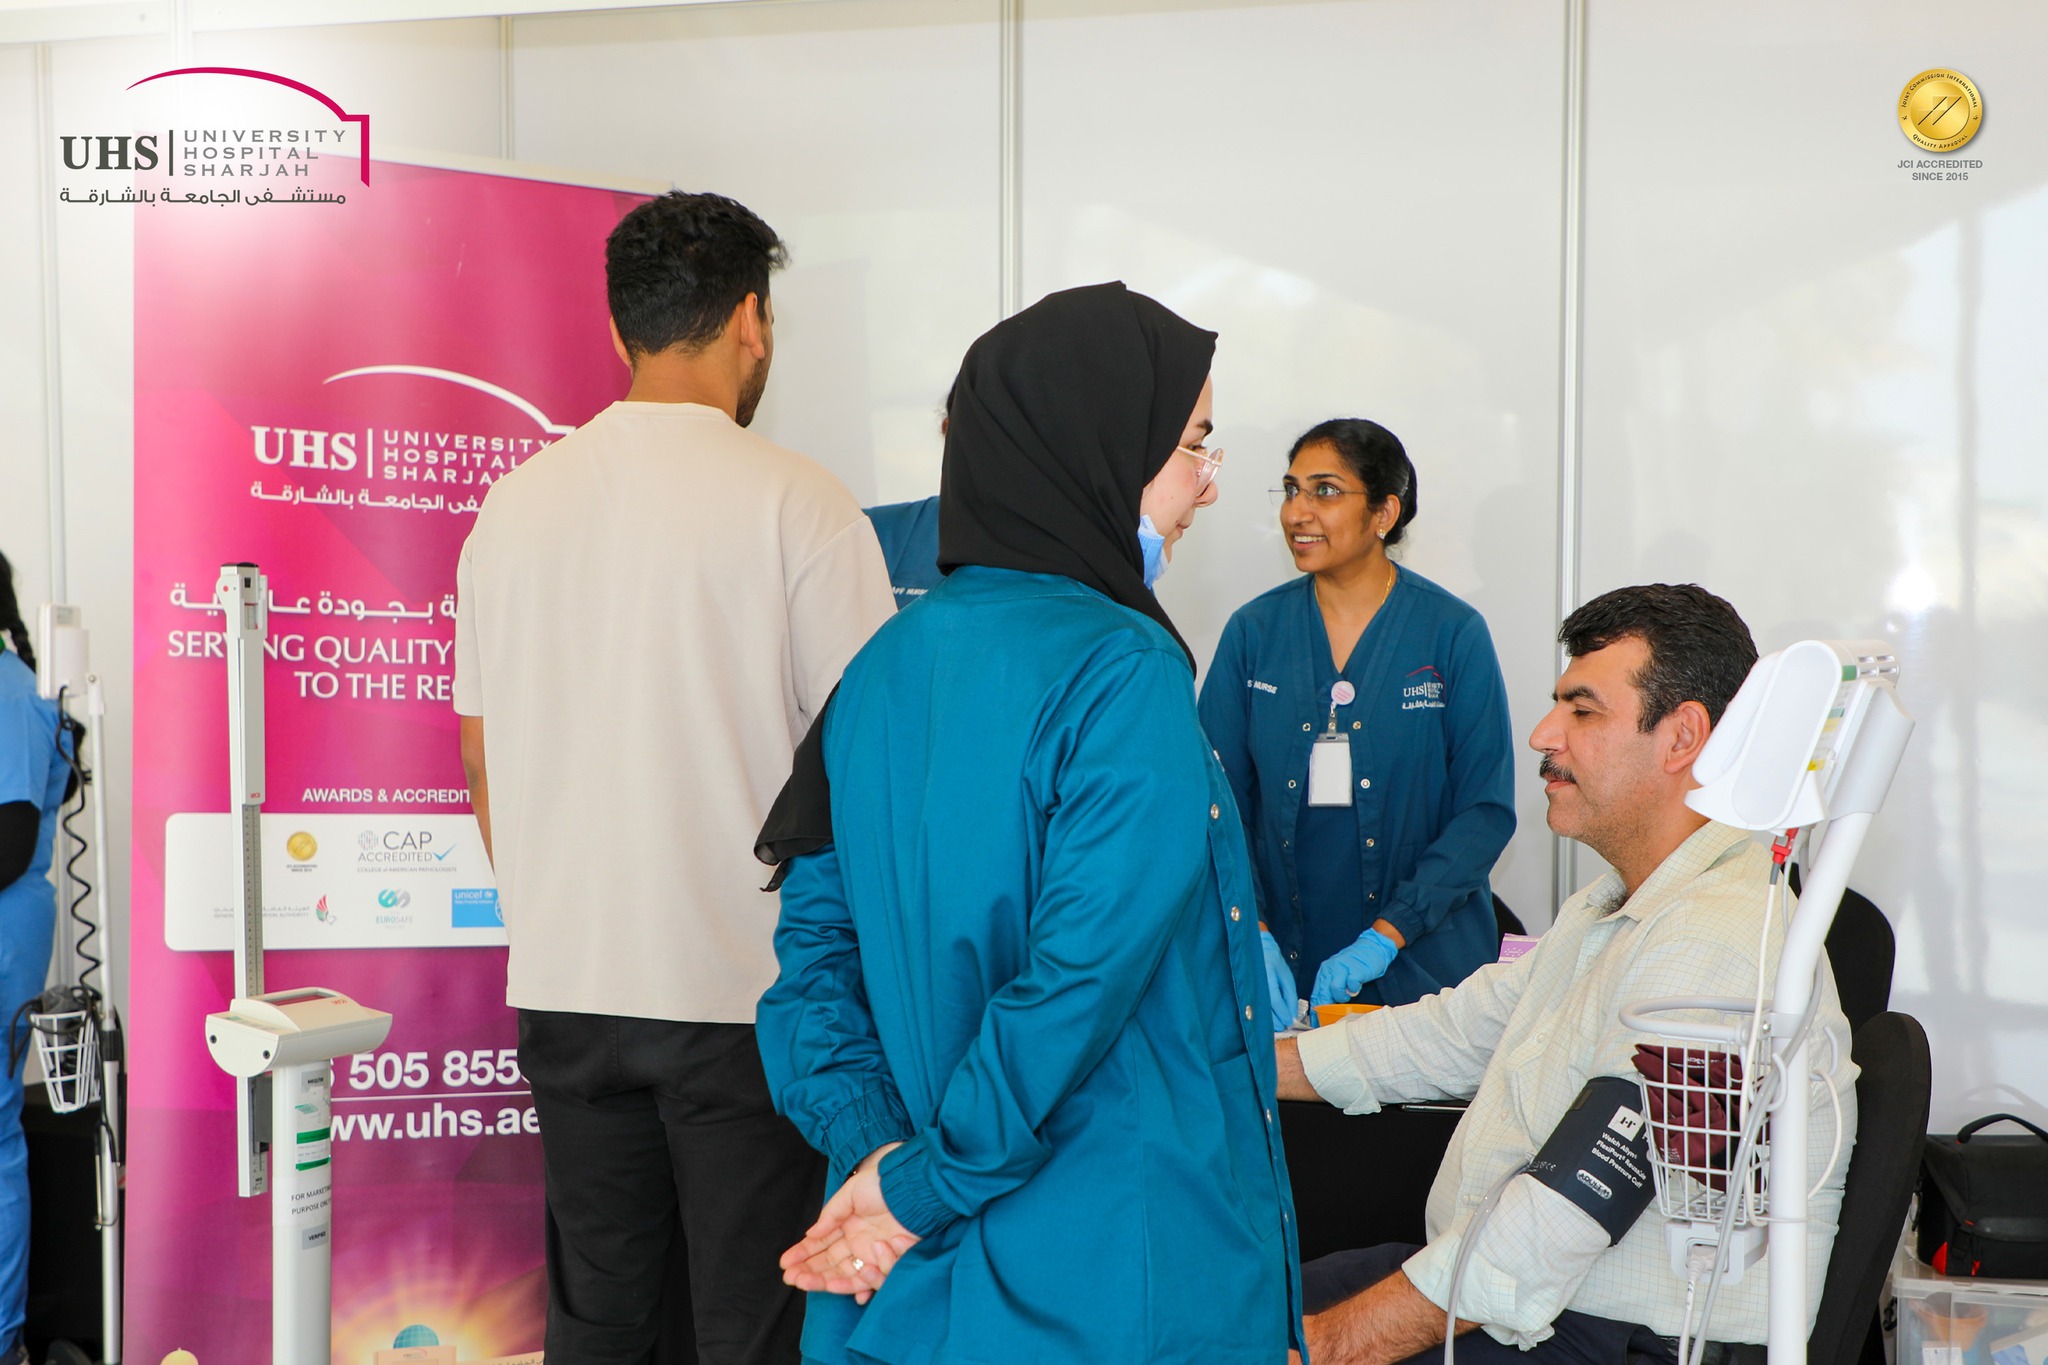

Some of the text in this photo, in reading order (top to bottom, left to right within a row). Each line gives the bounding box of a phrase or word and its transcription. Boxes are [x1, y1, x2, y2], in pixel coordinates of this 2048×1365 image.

[251, 425, 357, 471] UHS
[251, 480, 354, 510] بالشارقة
[359, 488, 443, 513] الجامعة
[168, 630, 453, 668] SERNG QUALITY
[294, 671, 455, 701] TO THE RE
[1403, 685, 1425, 698] UHS
[302, 788, 373, 803] AWARDS
[377, 788, 388, 803] &
[383, 831, 433, 850] CAP
[358, 852, 433, 862] ACCREDITED
[349, 1051, 429, 1090] 505
[442, 1048, 531, 1087] 855
[1602, 1132, 1621, 1148] Welch
[1591, 1147, 1643, 1189] Blood Pressure Cuff
[291, 1193, 305, 1201] FOR
[291, 1202, 319, 1215] PURPOSE
